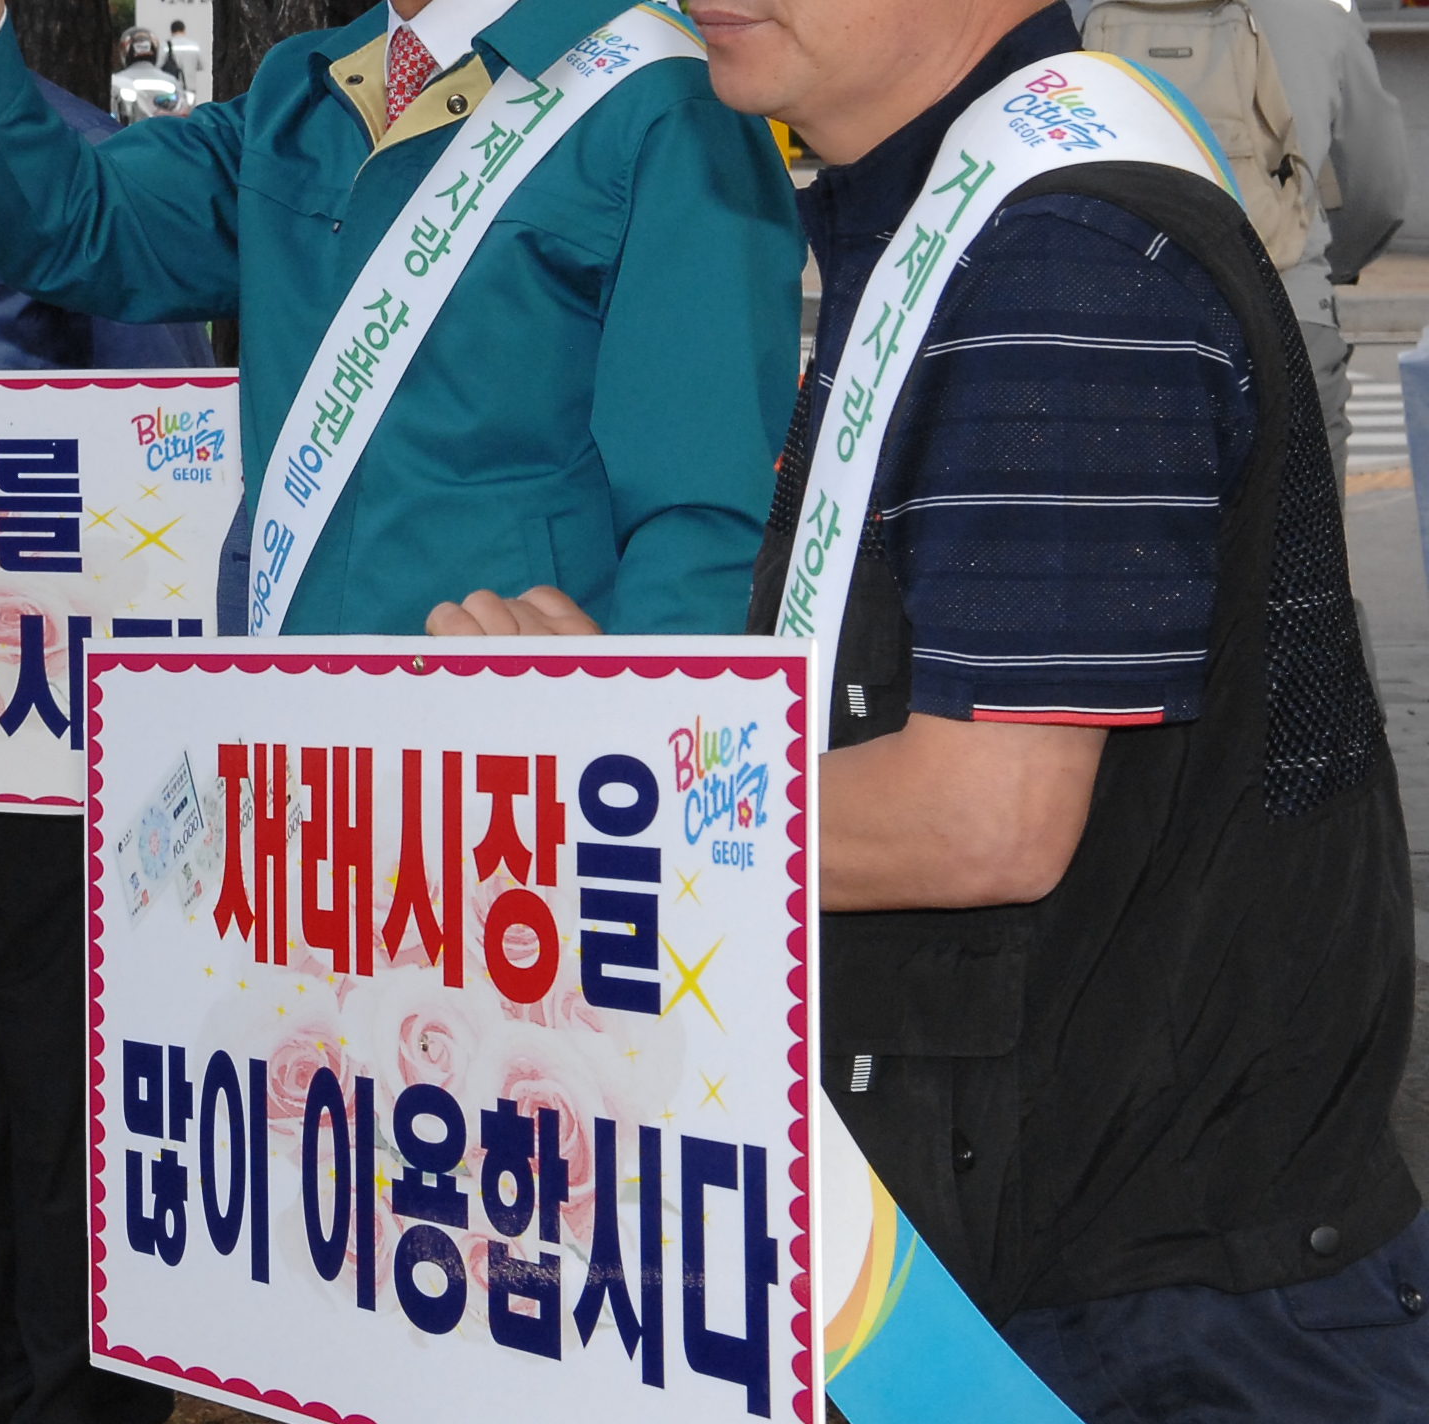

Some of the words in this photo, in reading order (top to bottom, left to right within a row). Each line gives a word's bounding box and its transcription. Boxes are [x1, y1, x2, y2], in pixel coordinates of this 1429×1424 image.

[565, 52, 597, 78] GEOJE
[1003, 93, 1072, 130] City
[1025, 69, 1097, 121] Blue
[1008, 117, 1046, 148] GEOJE
[403, 76, 565, 278] 거제사랑
[837, 150, 997, 464] 거제사랑
[131, 406, 194, 446] Blue
[147, 434, 195, 472] City
[172, 467, 213, 484] GEOJE
[668, 714, 735, 793] Blue
[684, 773, 735, 846] City
[212, 738, 662, 1017] 재래시장을
[712, 840, 755, 872] GEOJE
[121, 1039, 270, 1285] 많이
[301, 1064, 780, 1420] 이용합시다
